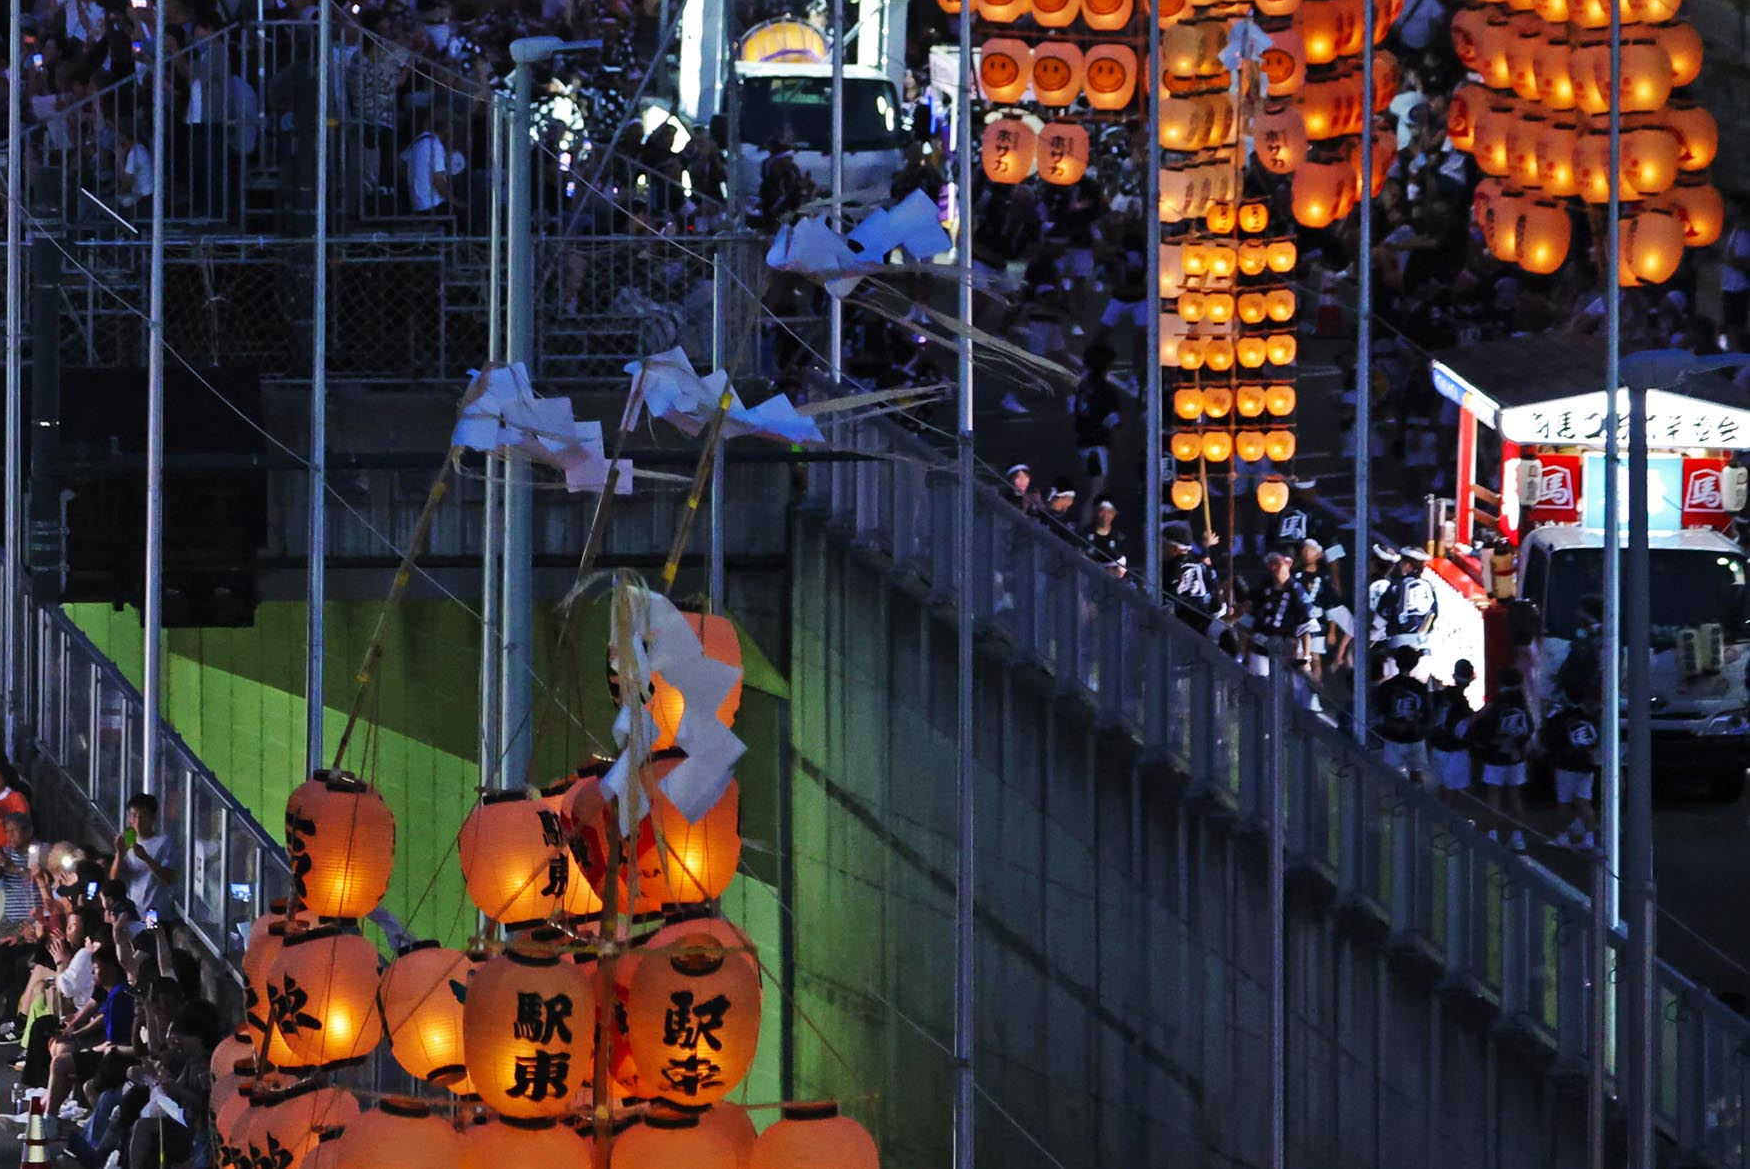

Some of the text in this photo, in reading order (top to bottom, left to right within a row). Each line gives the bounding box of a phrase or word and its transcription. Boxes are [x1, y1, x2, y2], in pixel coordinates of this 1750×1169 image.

[1539, 471, 1569, 506] 馬
[1690, 474, 1723, 507] 馬
[505, 991, 573, 1103] 駅東
